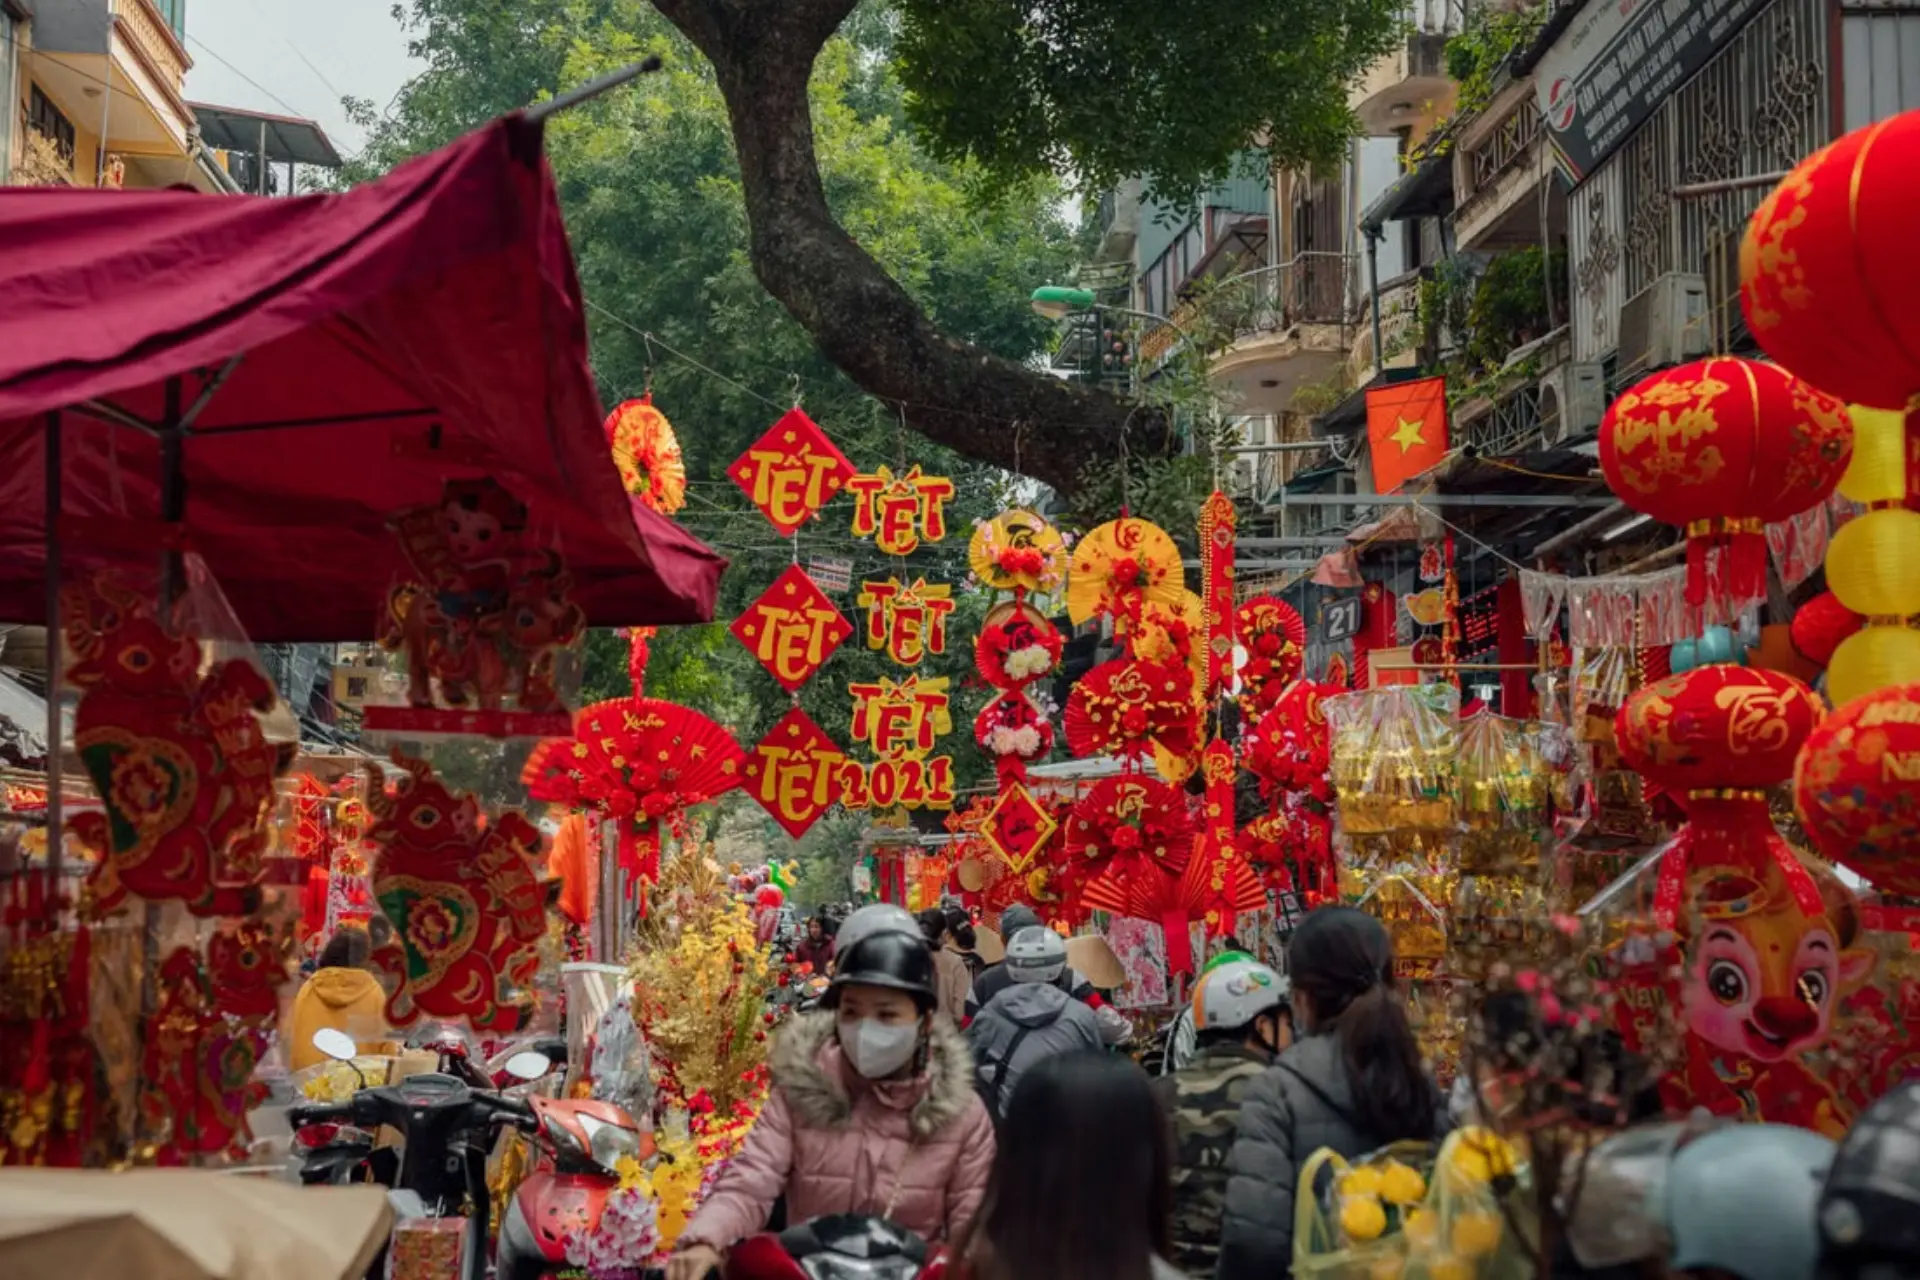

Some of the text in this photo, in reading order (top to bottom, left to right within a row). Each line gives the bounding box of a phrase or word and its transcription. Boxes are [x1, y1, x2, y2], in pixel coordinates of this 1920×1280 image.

[750, 443, 838, 525] TẾT
[849, 463, 955, 556] TẾT
[757, 596, 838, 681] TẾT
[862, 576, 956, 667] TẾT
[1328, 601, 1356, 638] 21
[848, 673, 949, 762] TẾT
[757, 736, 844, 822] TẾT
[840, 755, 954, 810] 2021
